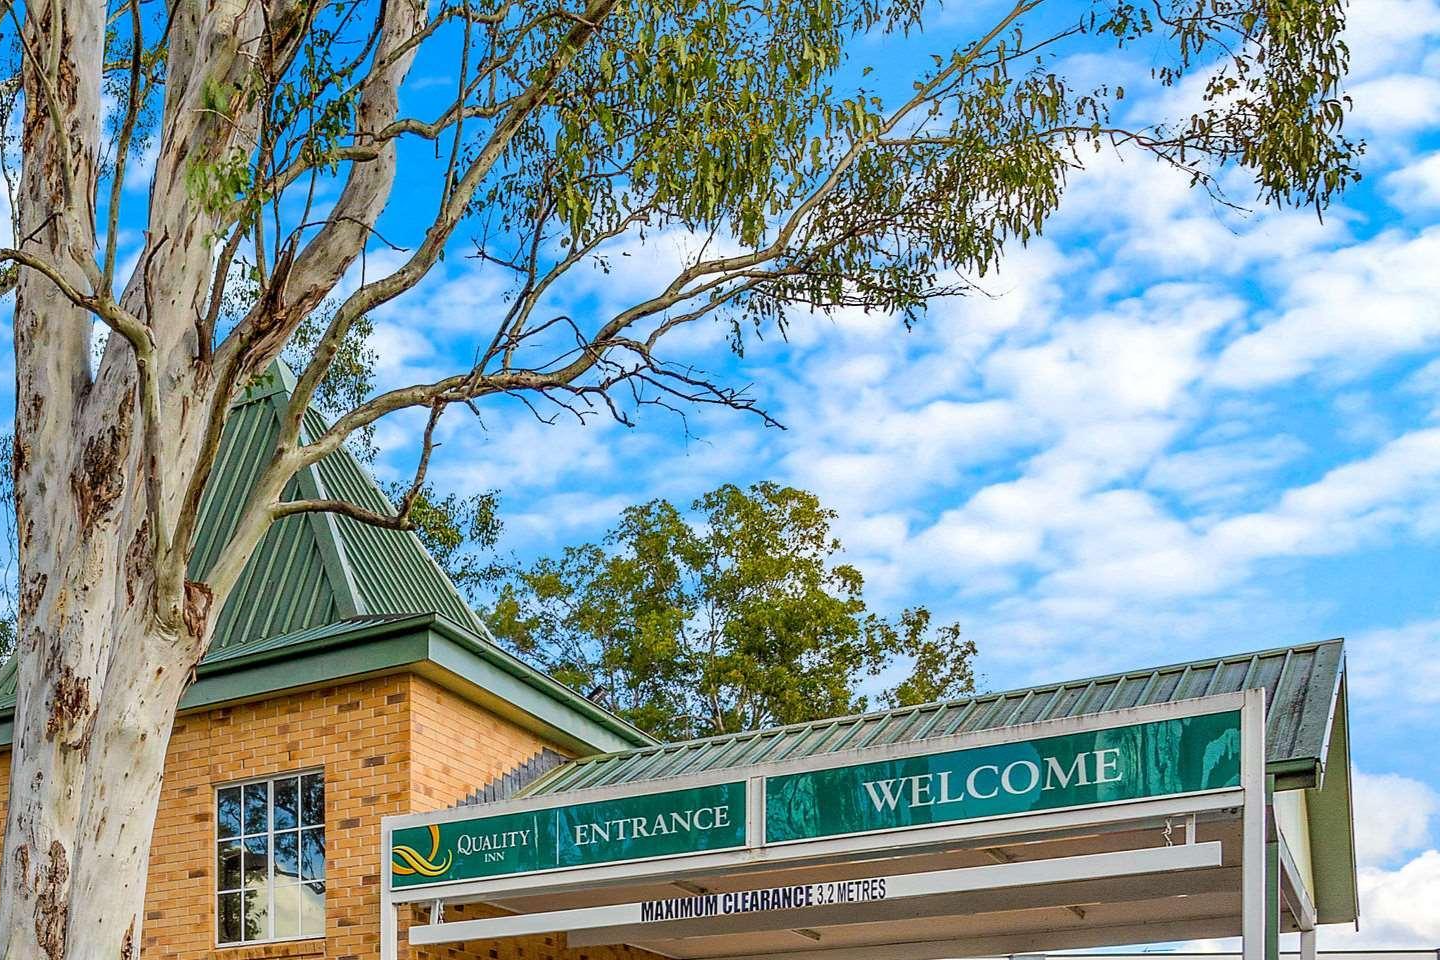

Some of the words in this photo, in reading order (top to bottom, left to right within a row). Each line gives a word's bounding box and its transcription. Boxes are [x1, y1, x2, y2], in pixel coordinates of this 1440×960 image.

[862, 748, 1124, 812] WELCOME
[457, 829, 531, 856] QUALITY
[573, 805, 731, 846] ENTRANCE
[484, 851, 505, 863] INN
[641, 895, 718, 922] MAXIMUM
[722, 885, 813, 915] CLEARANCE
[816, 883, 834, 905] 3.2
[837, 878, 886, 902] METRES
